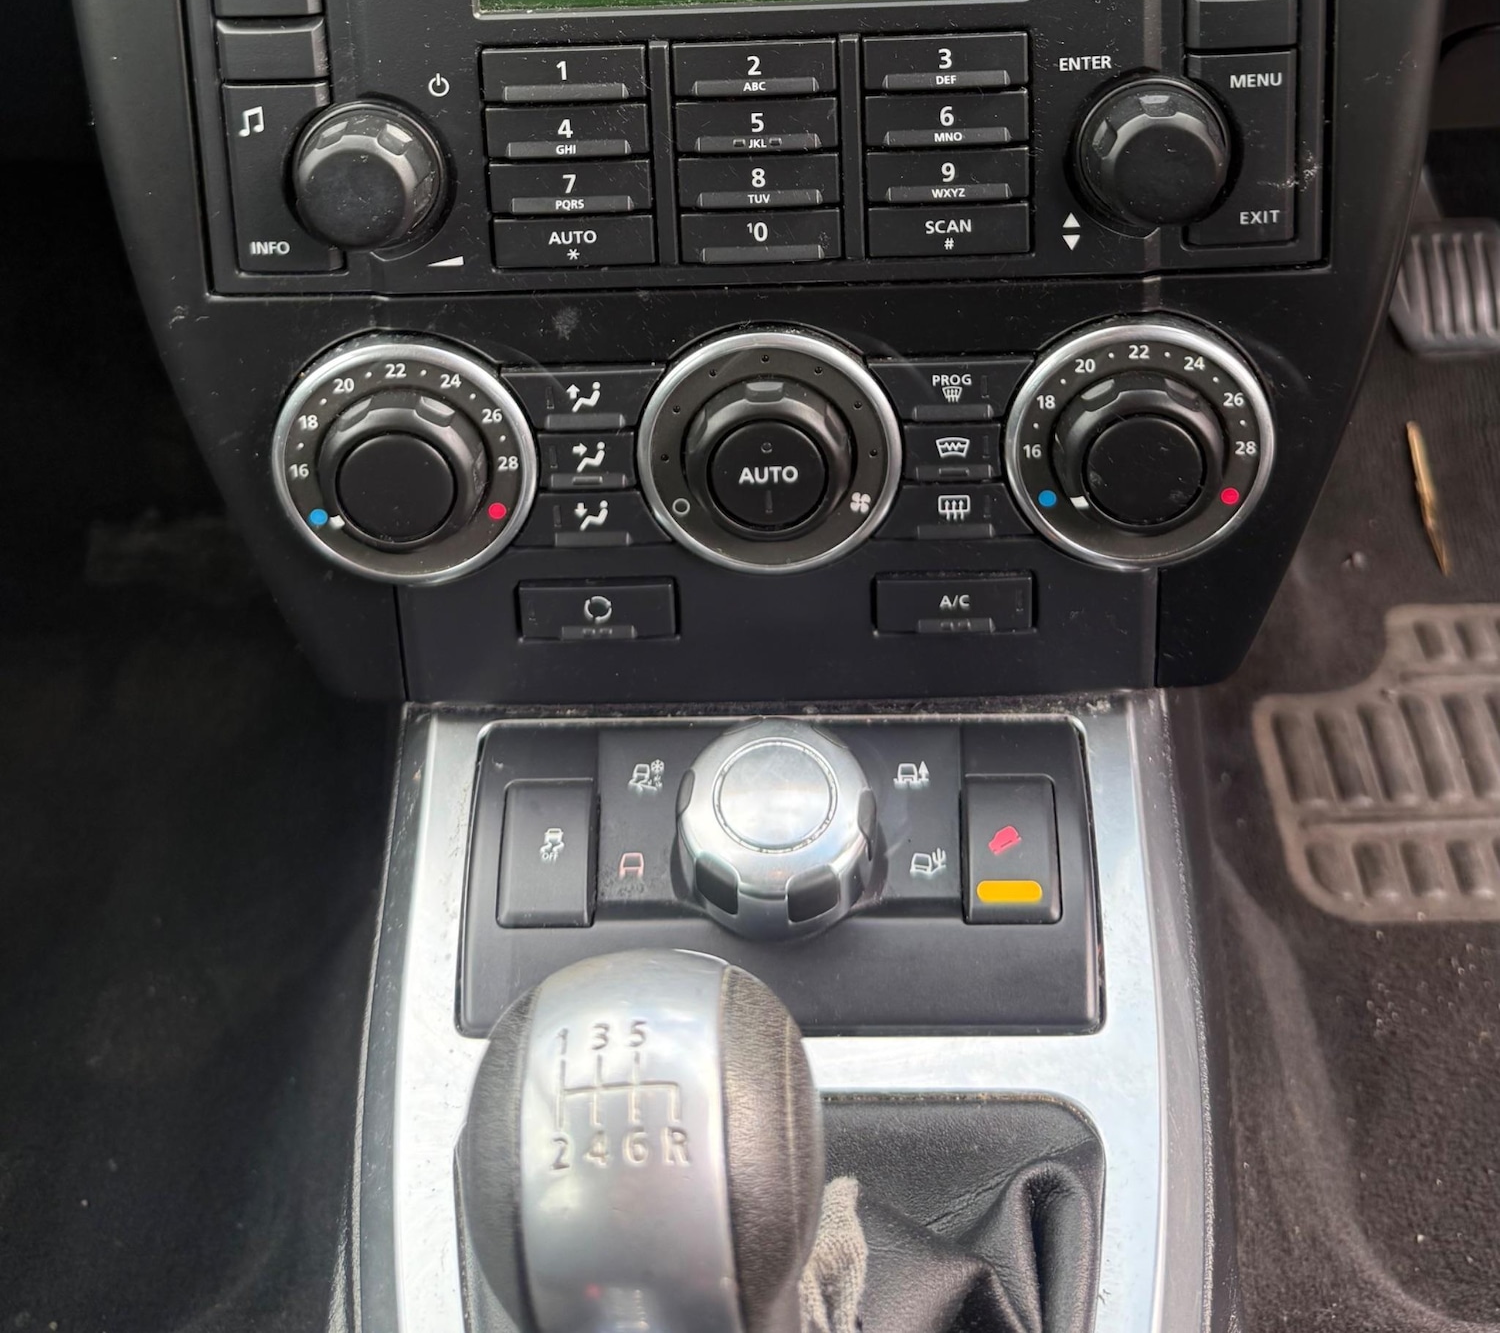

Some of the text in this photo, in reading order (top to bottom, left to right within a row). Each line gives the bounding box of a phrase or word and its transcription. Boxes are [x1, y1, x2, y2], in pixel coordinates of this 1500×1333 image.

[746, 55, 762, 76] 2
[938, 48, 953, 70] 3
[1059, 55, 1112, 72] ENTER
[556, 60, 567, 81] 1
[742, 81, 767, 92] ABC
[935, 74, 957, 86] DEF
[1230, 72, 1283, 89] MENU
[750, 112, 765, 133] 5
[939, 105, 955, 127] 6
[557, 118, 574, 139] 4
[748, 138, 768, 149] JKL
[933, 131, 963, 143] MNO
[555, 144, 577, 156] GHI
[751, 167, 766, 188] 8
[941, 162, 956, 183] 9
[562, 173, 577, 194] 7
[747, 193, 771, 204] TUV
[931, 187, 966, 199] WXYZ
[555, 198, 585, 212] PQRS
[1239, 209, 1281, 225] EXIT
[925, 218, 972, 235] SCAN
[548, 230, 597, 245] AUTO
[249, 241, 291, 255] INFO
[1128, 344, 1150, 360] 22
[384, 362, 407, 379] 22
[1074, 358, 1096, 374] 20
[1183, 356, 1206, 371] 24
[333, 377, 355, 394] 20
[440, 372, 463, 389] 24
[932, 373, 972, 387] PROG
[1036, 394, 1056, 410] 18
[1223, 392, 1245, 408] 26
[298, 414, 319, 431] 18
[481, 407, 504, 424] 26
[1023, 443, 1042, 459] 16
[1234, 440, 1257, 456] 28
[289, 463, 310, 479] 16
[497, 455, 519, 472] 28
[738, 465, 799, 484] AUTO
[939, 594, 970, 609] A/C
[540, 851, 560, 863] OFF
[555, 1019, 647, 1054] 1 3 5
[552, 1128, 692, 1170] 2 4 6 R
